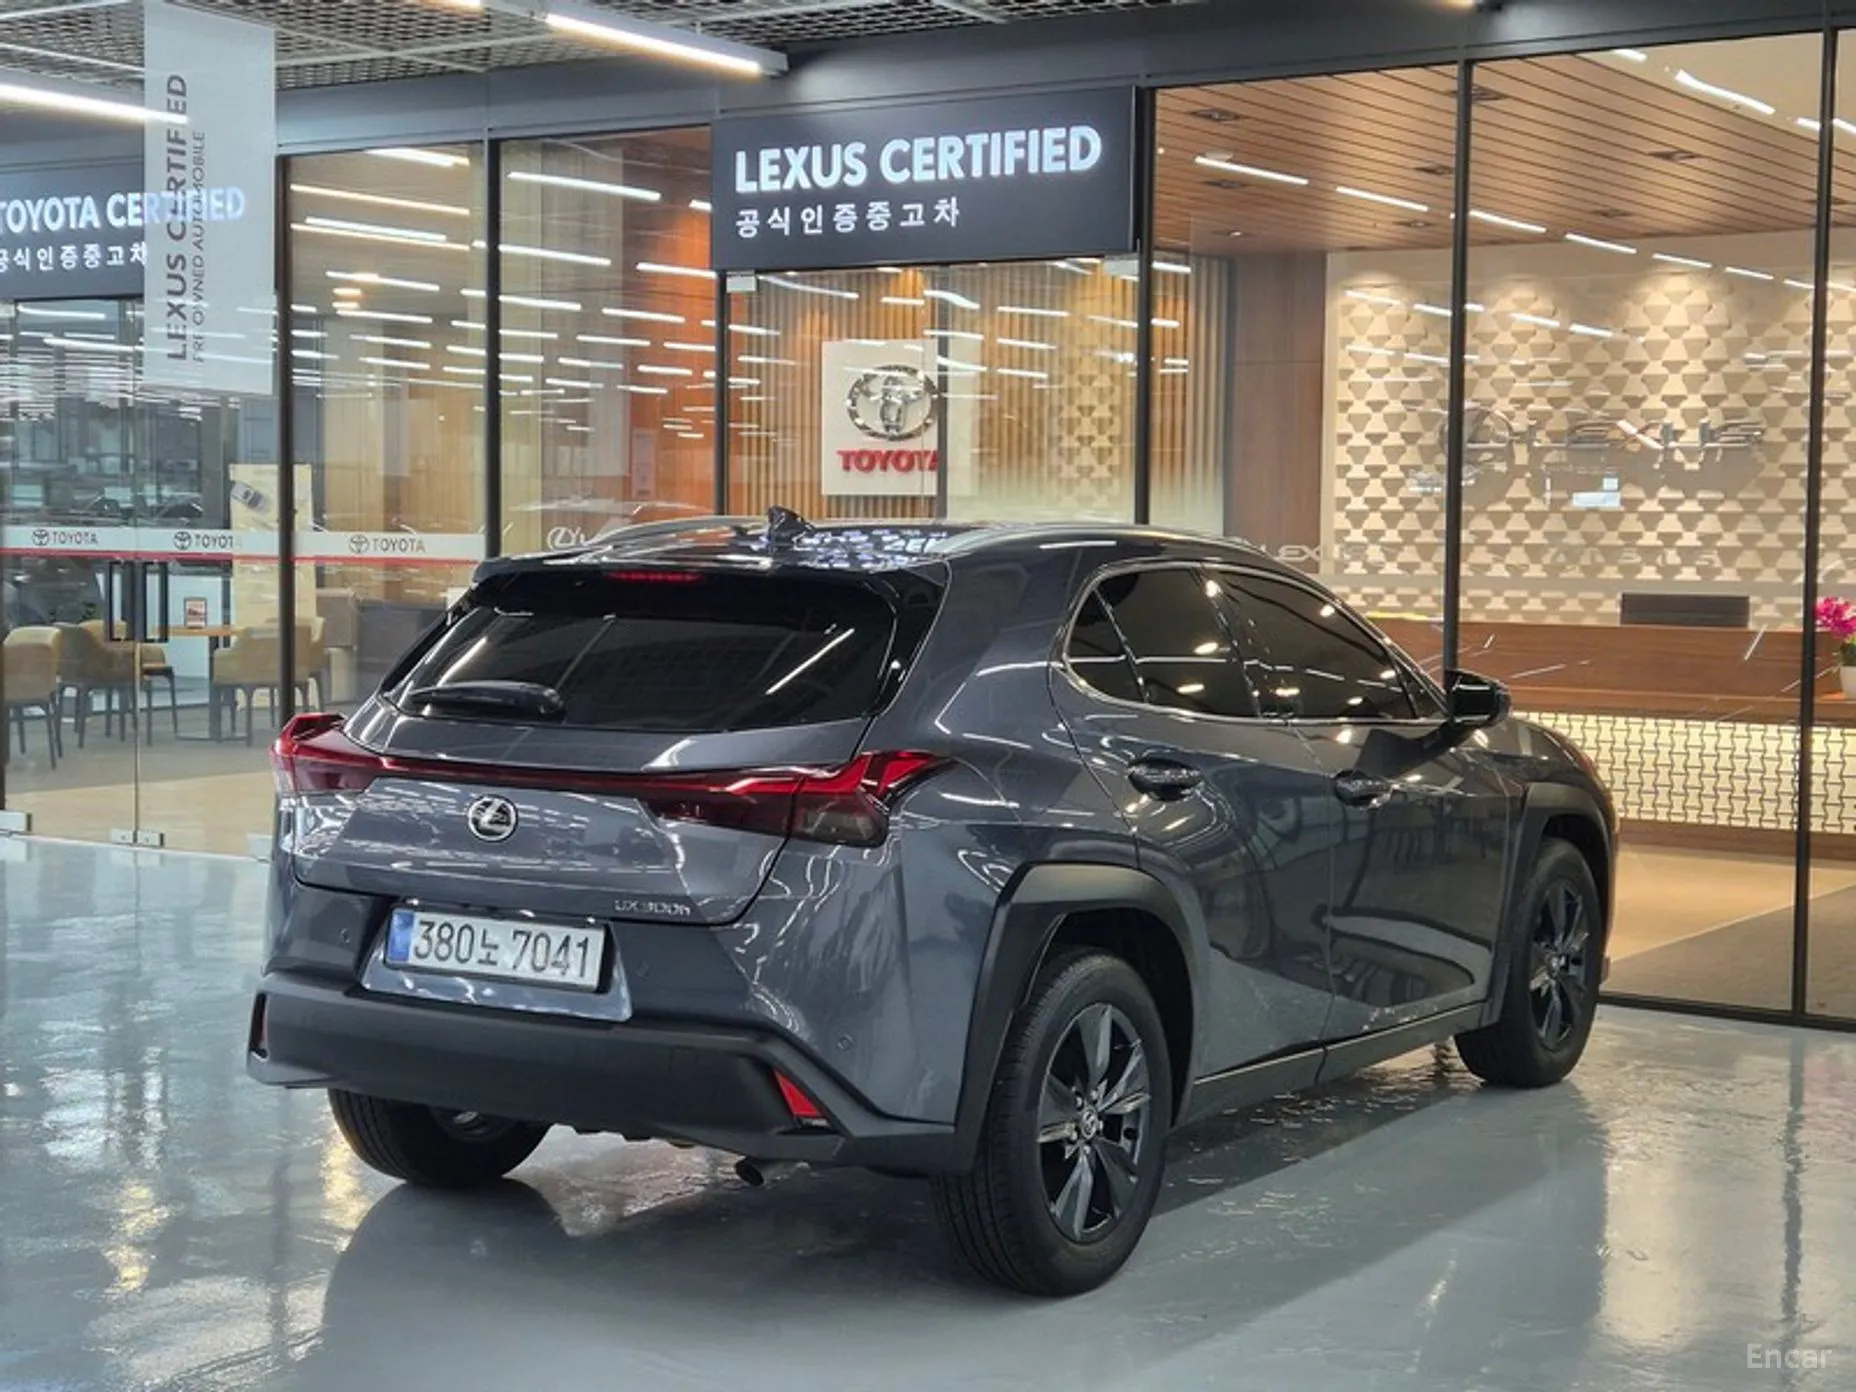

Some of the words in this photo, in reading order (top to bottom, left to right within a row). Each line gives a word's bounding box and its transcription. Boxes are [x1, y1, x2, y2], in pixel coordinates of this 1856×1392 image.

[166, 73, 188, 241] CERTIFED
[735, 142, 868, 194] LEXUS
[879, 125, 1102, 183] CERTIFIED
[106, 186, 246, 227] CERTIFIED
[735, 197, 960, 238] 공식인증중고차
[166, 253, 188, 361] LEXUS
[52, 532, 98, 545] TOYOTA
[195, 533, 240, 548] TOYOT
[372, 538, 425, 553] TOYOTA
[413, 920, 499, 967] 380노
[512, 929, 589, 978] 7041
